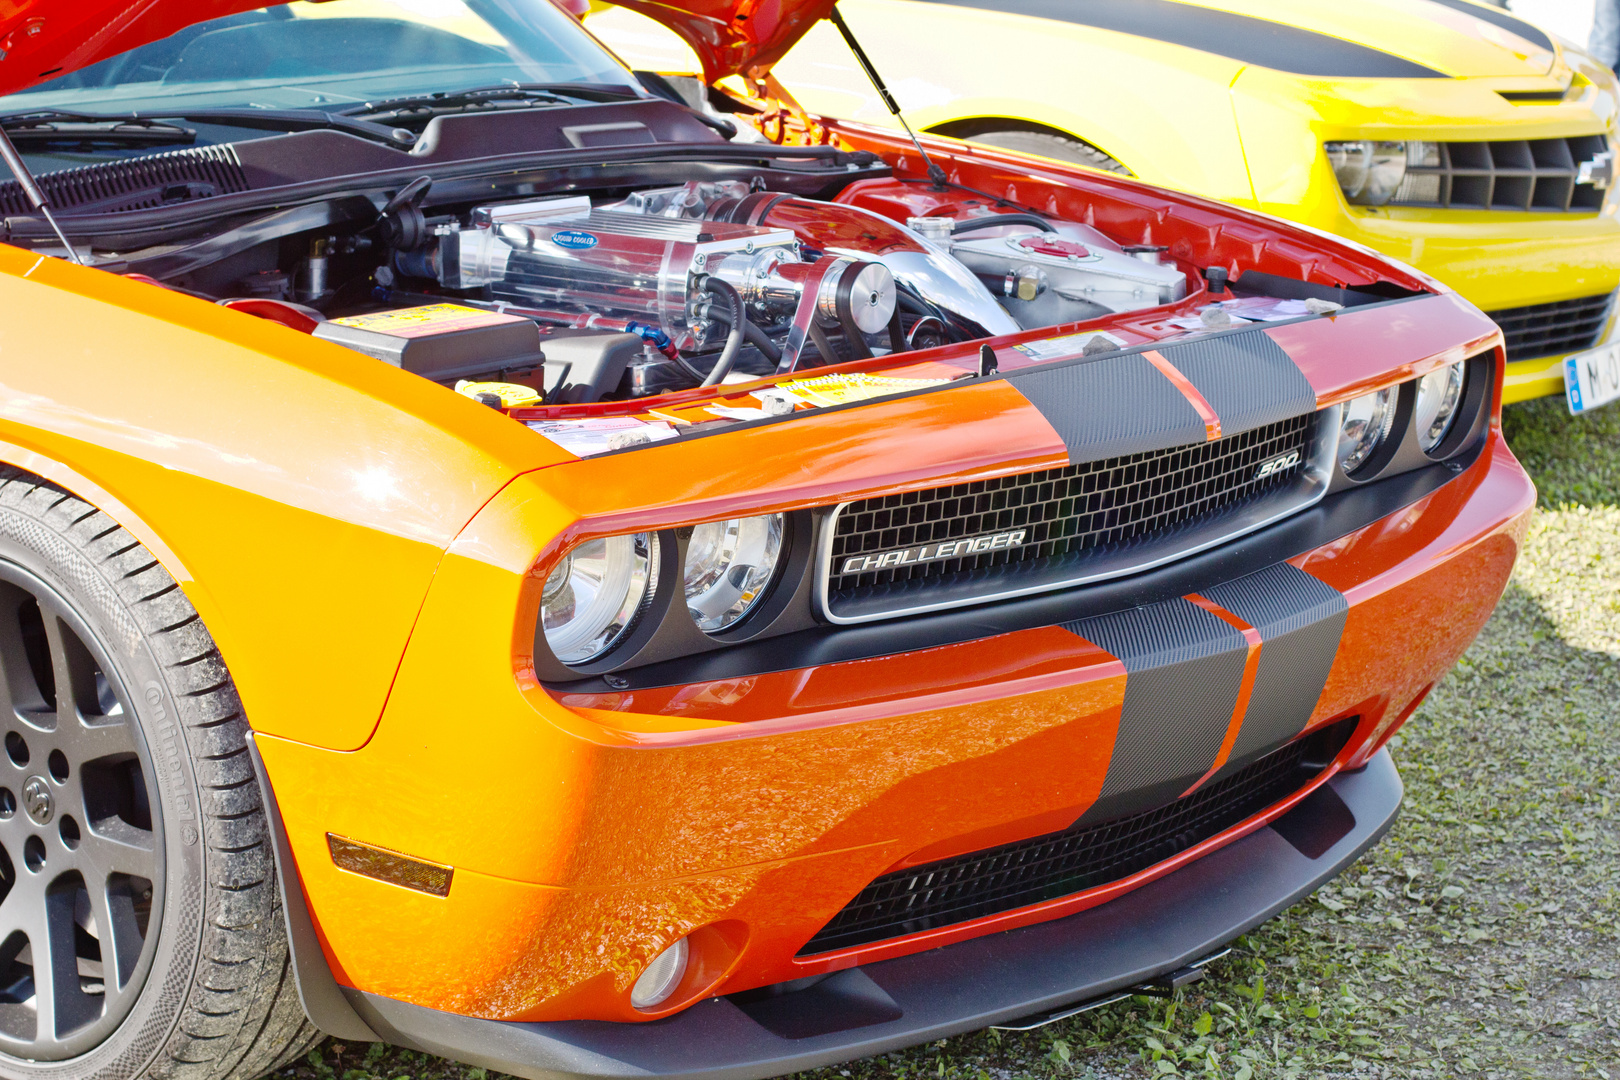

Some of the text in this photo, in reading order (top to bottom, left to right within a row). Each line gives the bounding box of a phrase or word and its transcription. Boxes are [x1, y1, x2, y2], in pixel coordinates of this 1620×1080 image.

[573, 236, 593, 245] COOLED
[1258, 452, 1299, 479] 500
[842, 528, 1027, 574] CHALLENGER
[144, 679, 196, 822] Continental
